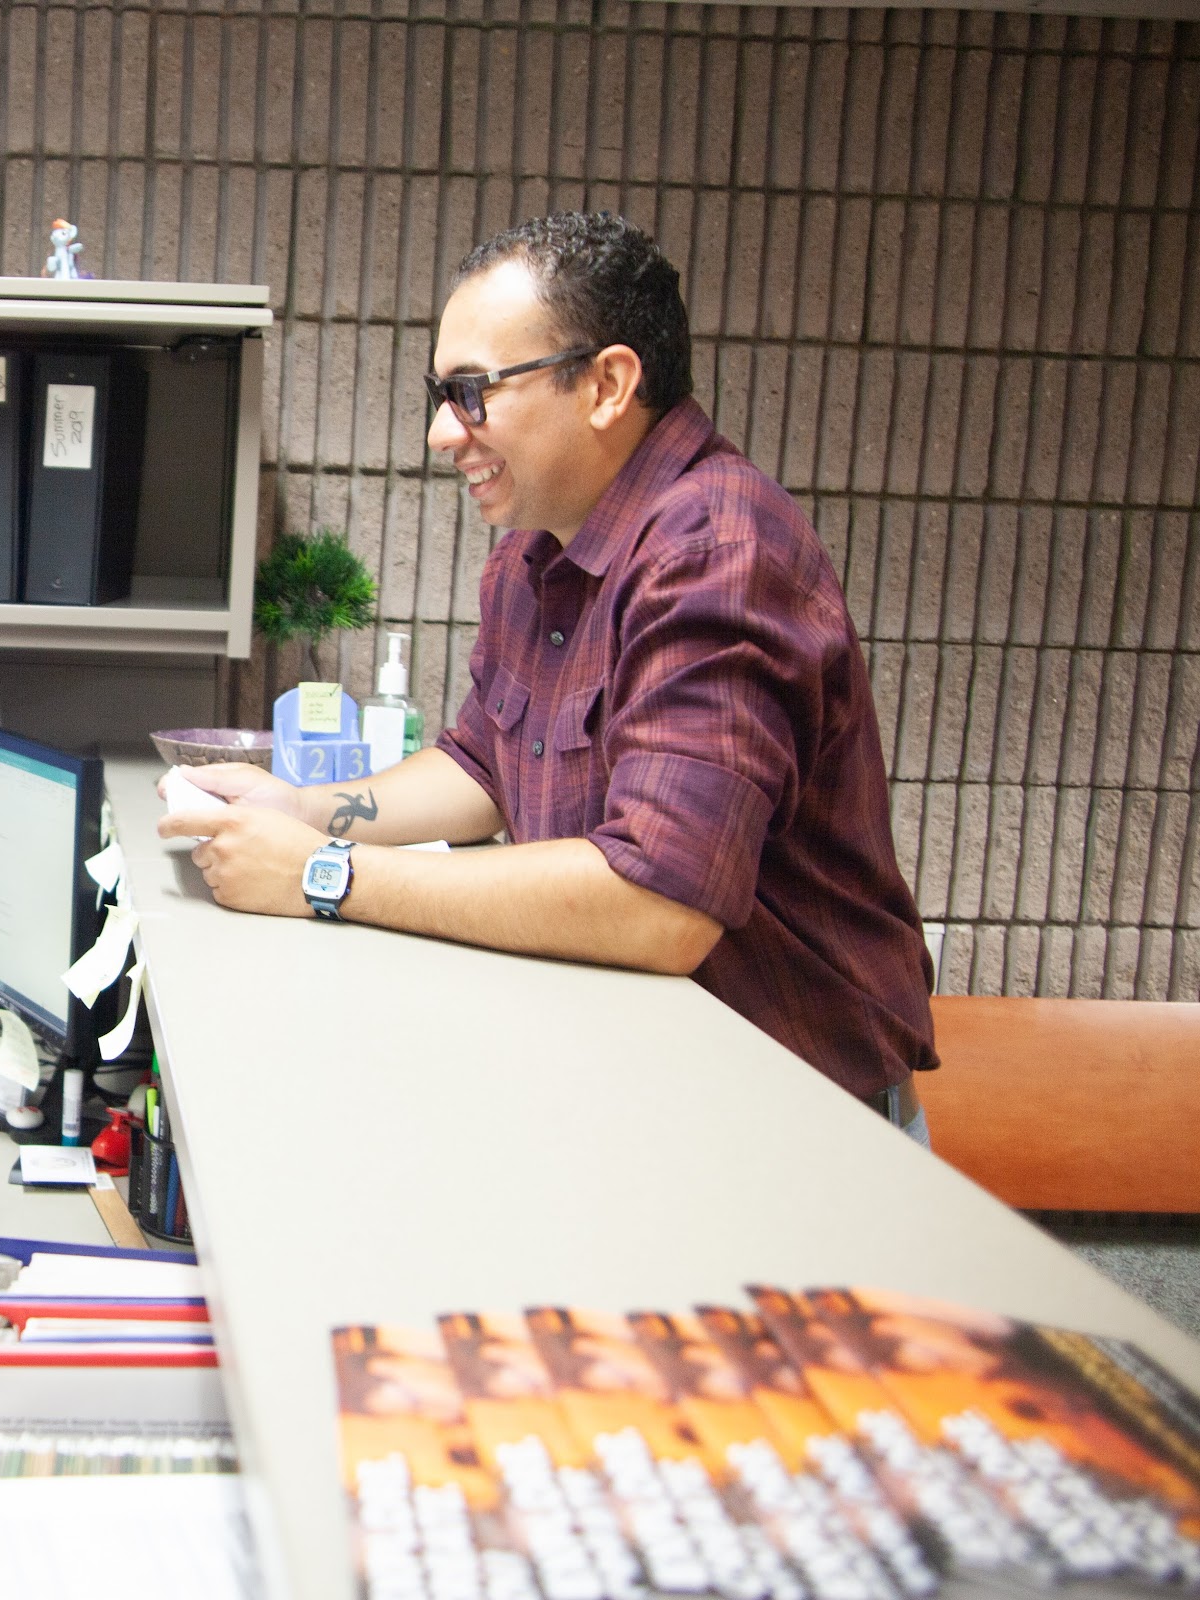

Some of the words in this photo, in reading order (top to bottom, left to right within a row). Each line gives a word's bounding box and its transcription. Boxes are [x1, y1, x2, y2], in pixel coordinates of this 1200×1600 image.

[50, 394, 67, 458] Summer
[308, 747, 327, 779] 2
[347, 747, 365, 779] 3
